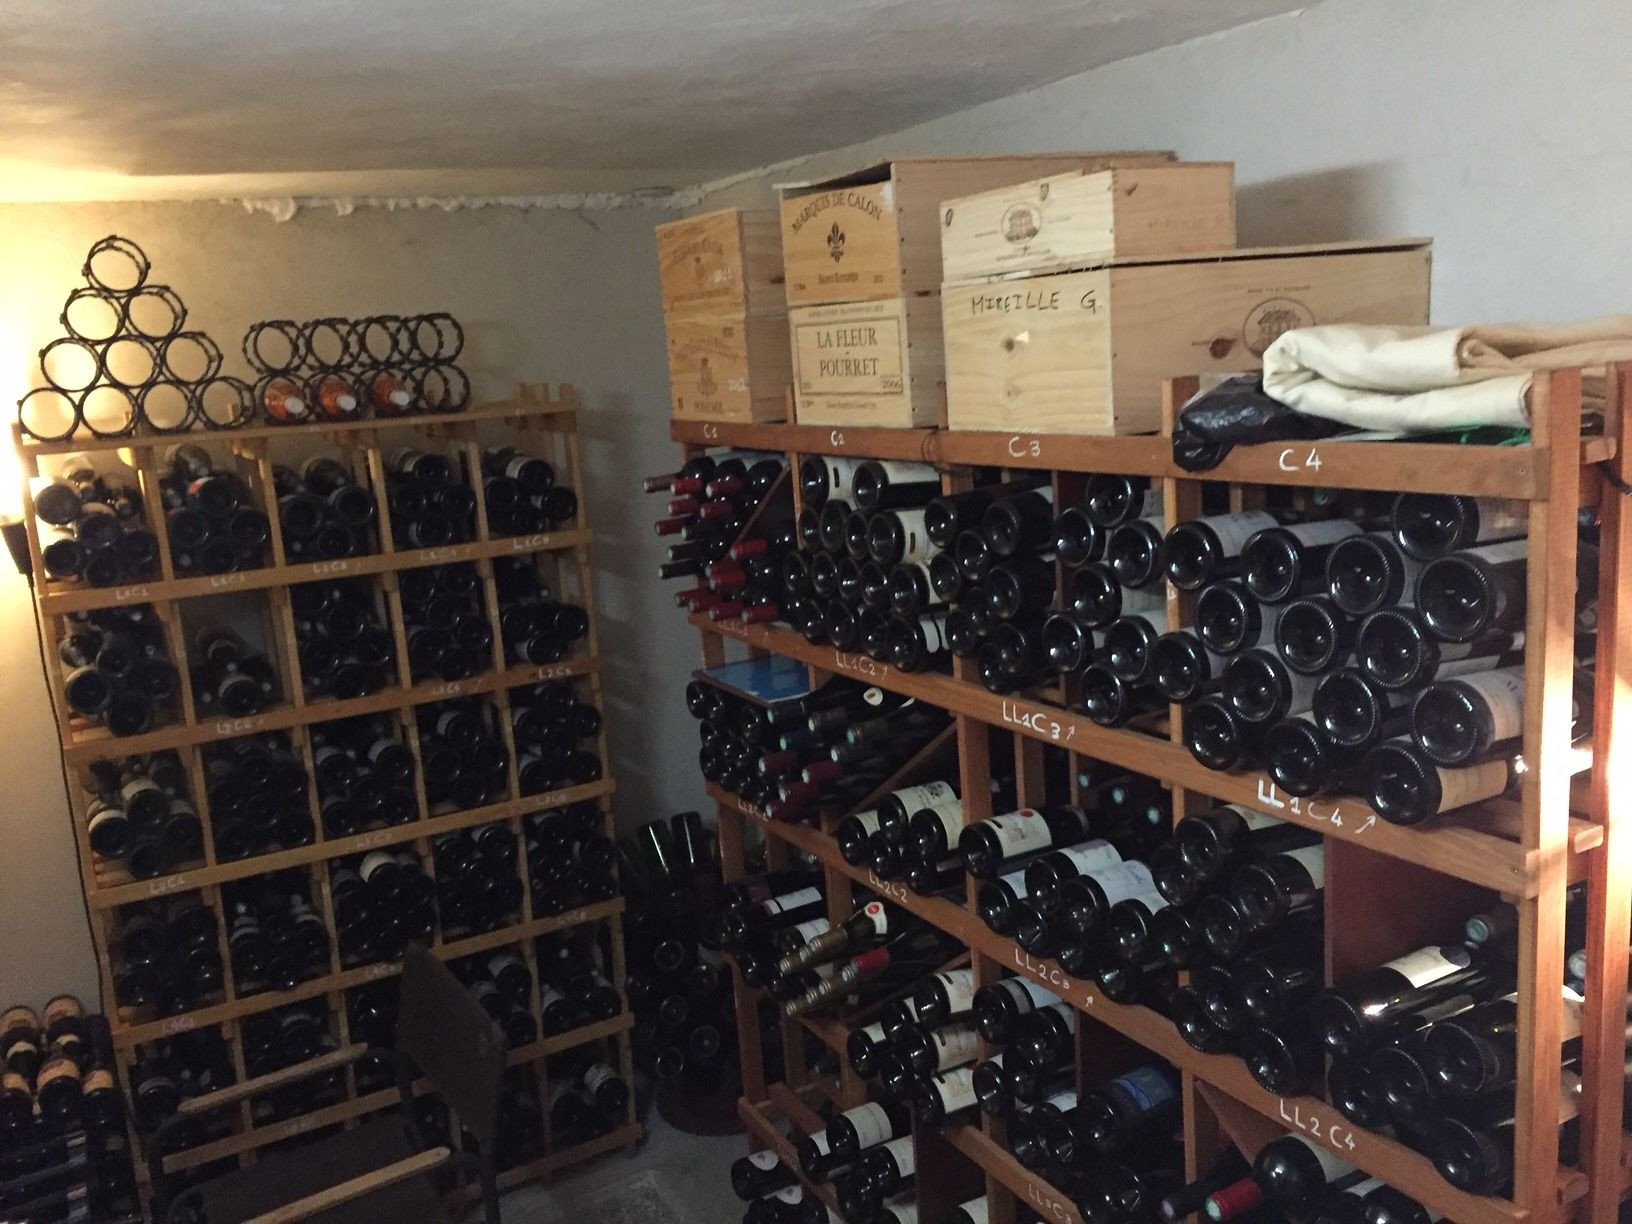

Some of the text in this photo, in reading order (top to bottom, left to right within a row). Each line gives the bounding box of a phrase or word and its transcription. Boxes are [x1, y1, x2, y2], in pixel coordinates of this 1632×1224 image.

[792, 191, 882, 235] MARQUIS DE CALON
[972, 289, 1096, 316] MIREILLE G
[817, 327, 879, 349] LA FLEUR
[820, 357, 879, 377] POURRET
[836, 651, 876, 676] LL1C2
[869, 868, 908, 903] LL2C2
